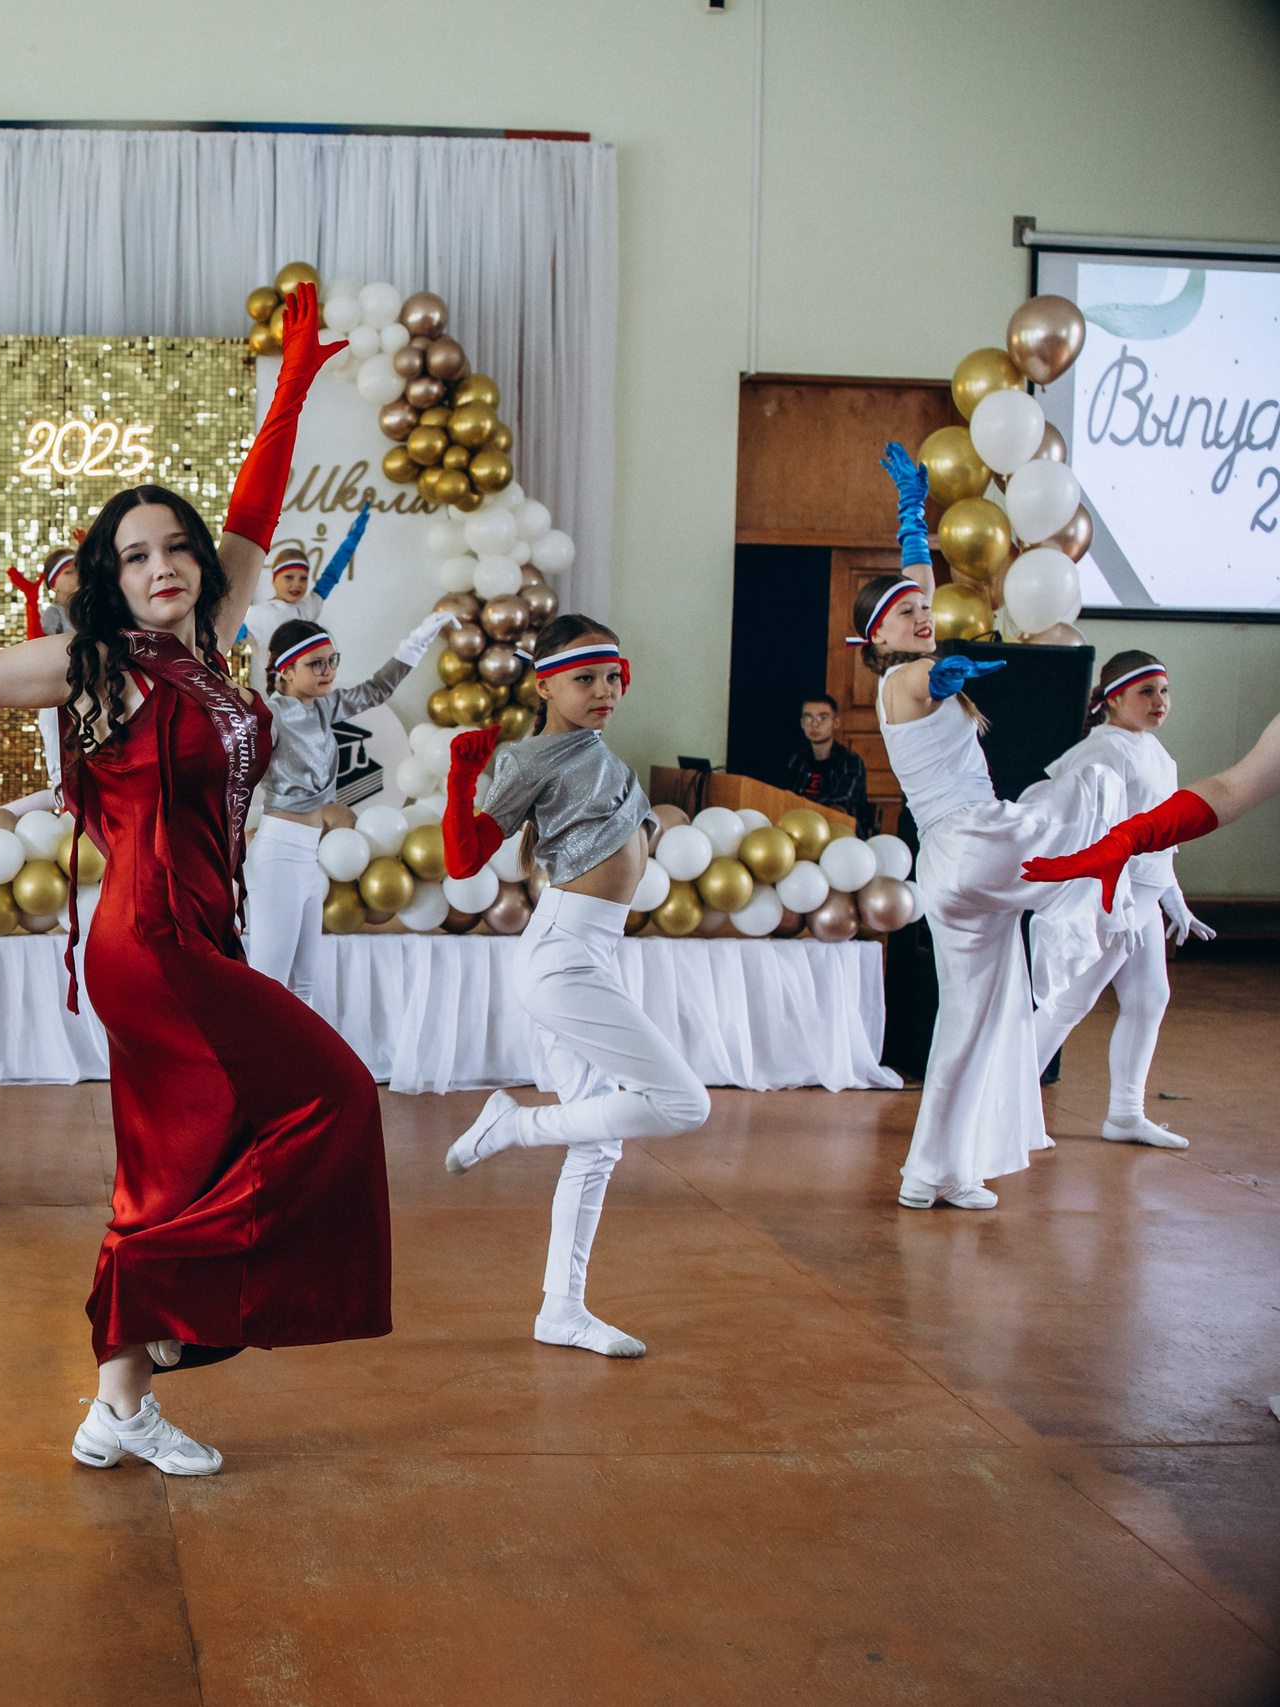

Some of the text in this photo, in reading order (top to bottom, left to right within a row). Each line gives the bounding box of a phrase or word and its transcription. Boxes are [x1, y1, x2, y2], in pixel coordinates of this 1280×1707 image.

[20, 419, 153, 477] 2025
[1087, 344, 1280, 494] Выпус
[282, 459, 440, 515] Школа
